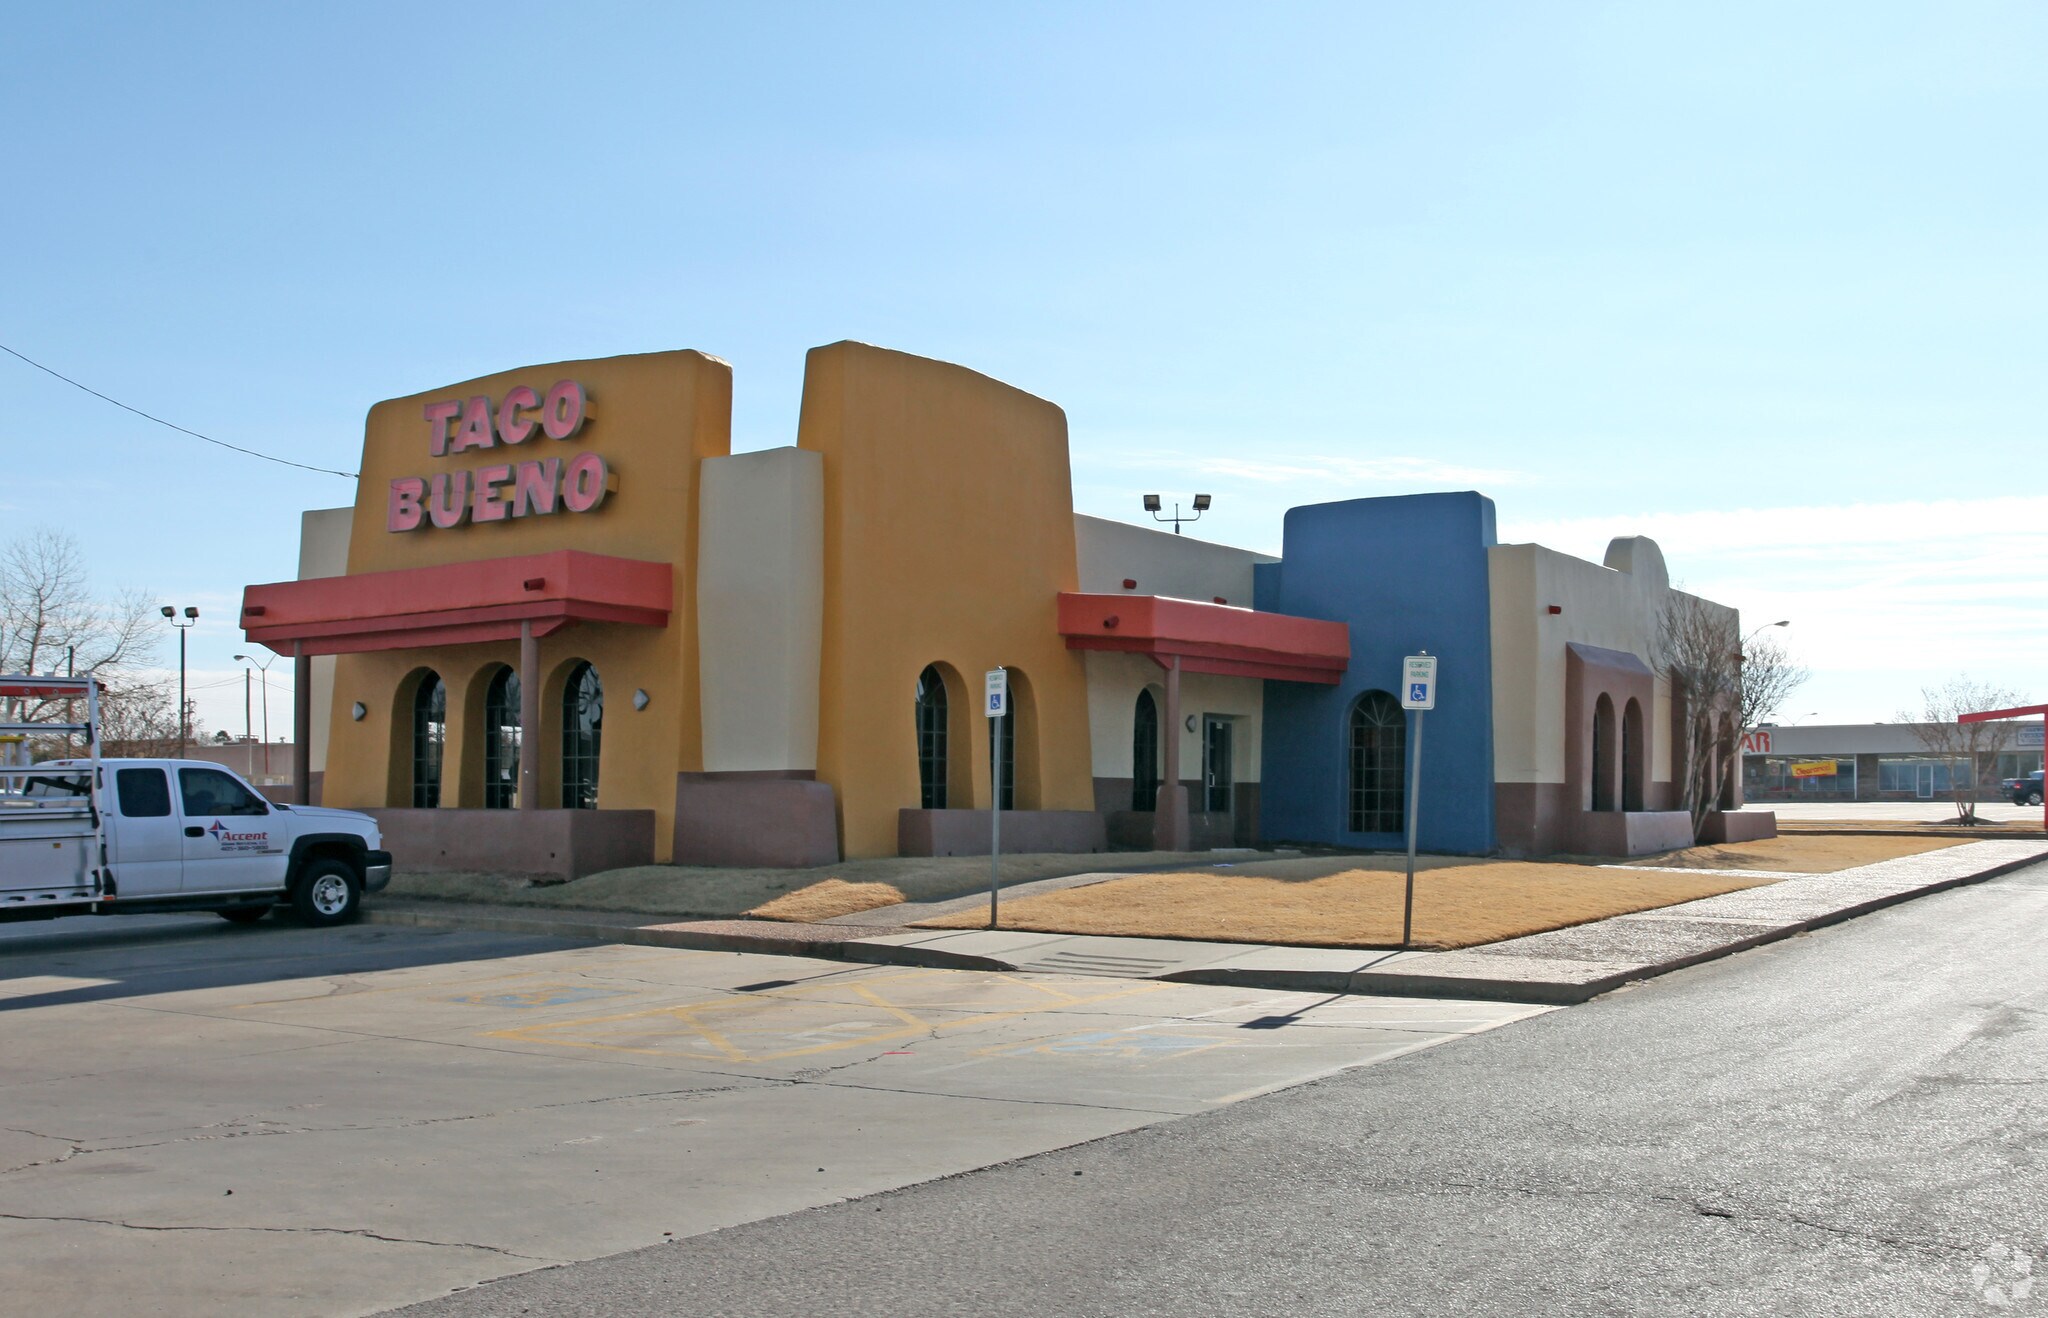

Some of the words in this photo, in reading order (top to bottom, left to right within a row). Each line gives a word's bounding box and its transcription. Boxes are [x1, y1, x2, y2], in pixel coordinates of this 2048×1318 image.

[424, 379, 586, 457] TACO
[387, 452, 608, 533] BUENO
[221, 831, 268, 841] Accent
